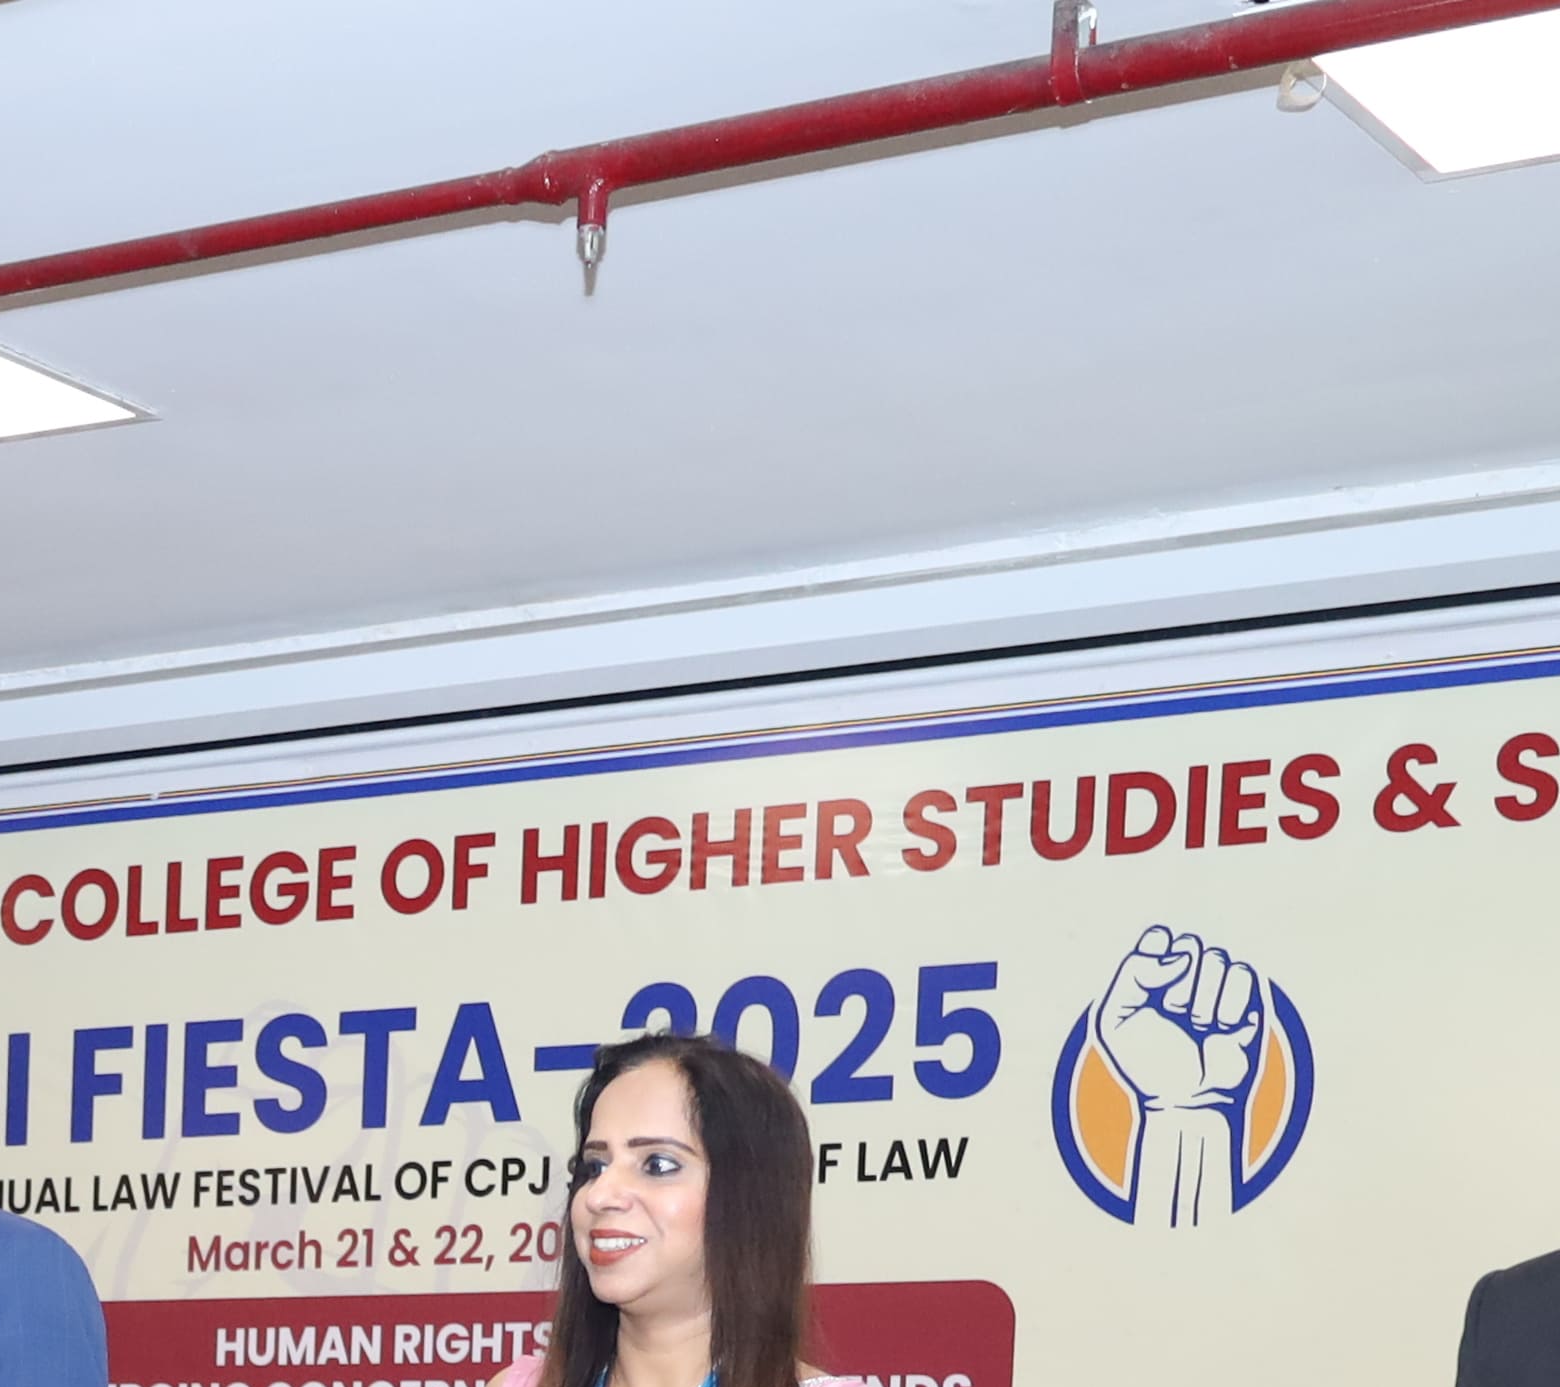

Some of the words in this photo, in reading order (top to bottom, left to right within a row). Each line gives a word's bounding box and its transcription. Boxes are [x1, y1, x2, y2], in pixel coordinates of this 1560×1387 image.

[0, 845, 358, 946] COLLEGE
[382, 831, 497, 916] OF
[521, 798, 873, 906] HIGHER
[902, 752, 1341, 873] STUDIES
[1374, 742, 1460, 833] &
[92, 1172, 181, 1212] LAW
[193, 1163, 382, 1208] FESTIVAL
[394, 1159, 453, 1201] OF
[464, 1155, 551, 1198] CPJ
[856, 1136, 970, 1183] LAW
[186, 1230, 323, 1273] March
[335, 1228, 375, 1269] 21
[387, 1228, 421, 1268] &
[432, 1223, 495, 1273] 22,
[508, 1221, 564, 1264] 20
[215, 1325, 383, 1367] HUMAN
[393, 1321, 553, 1365] RIGHTS
